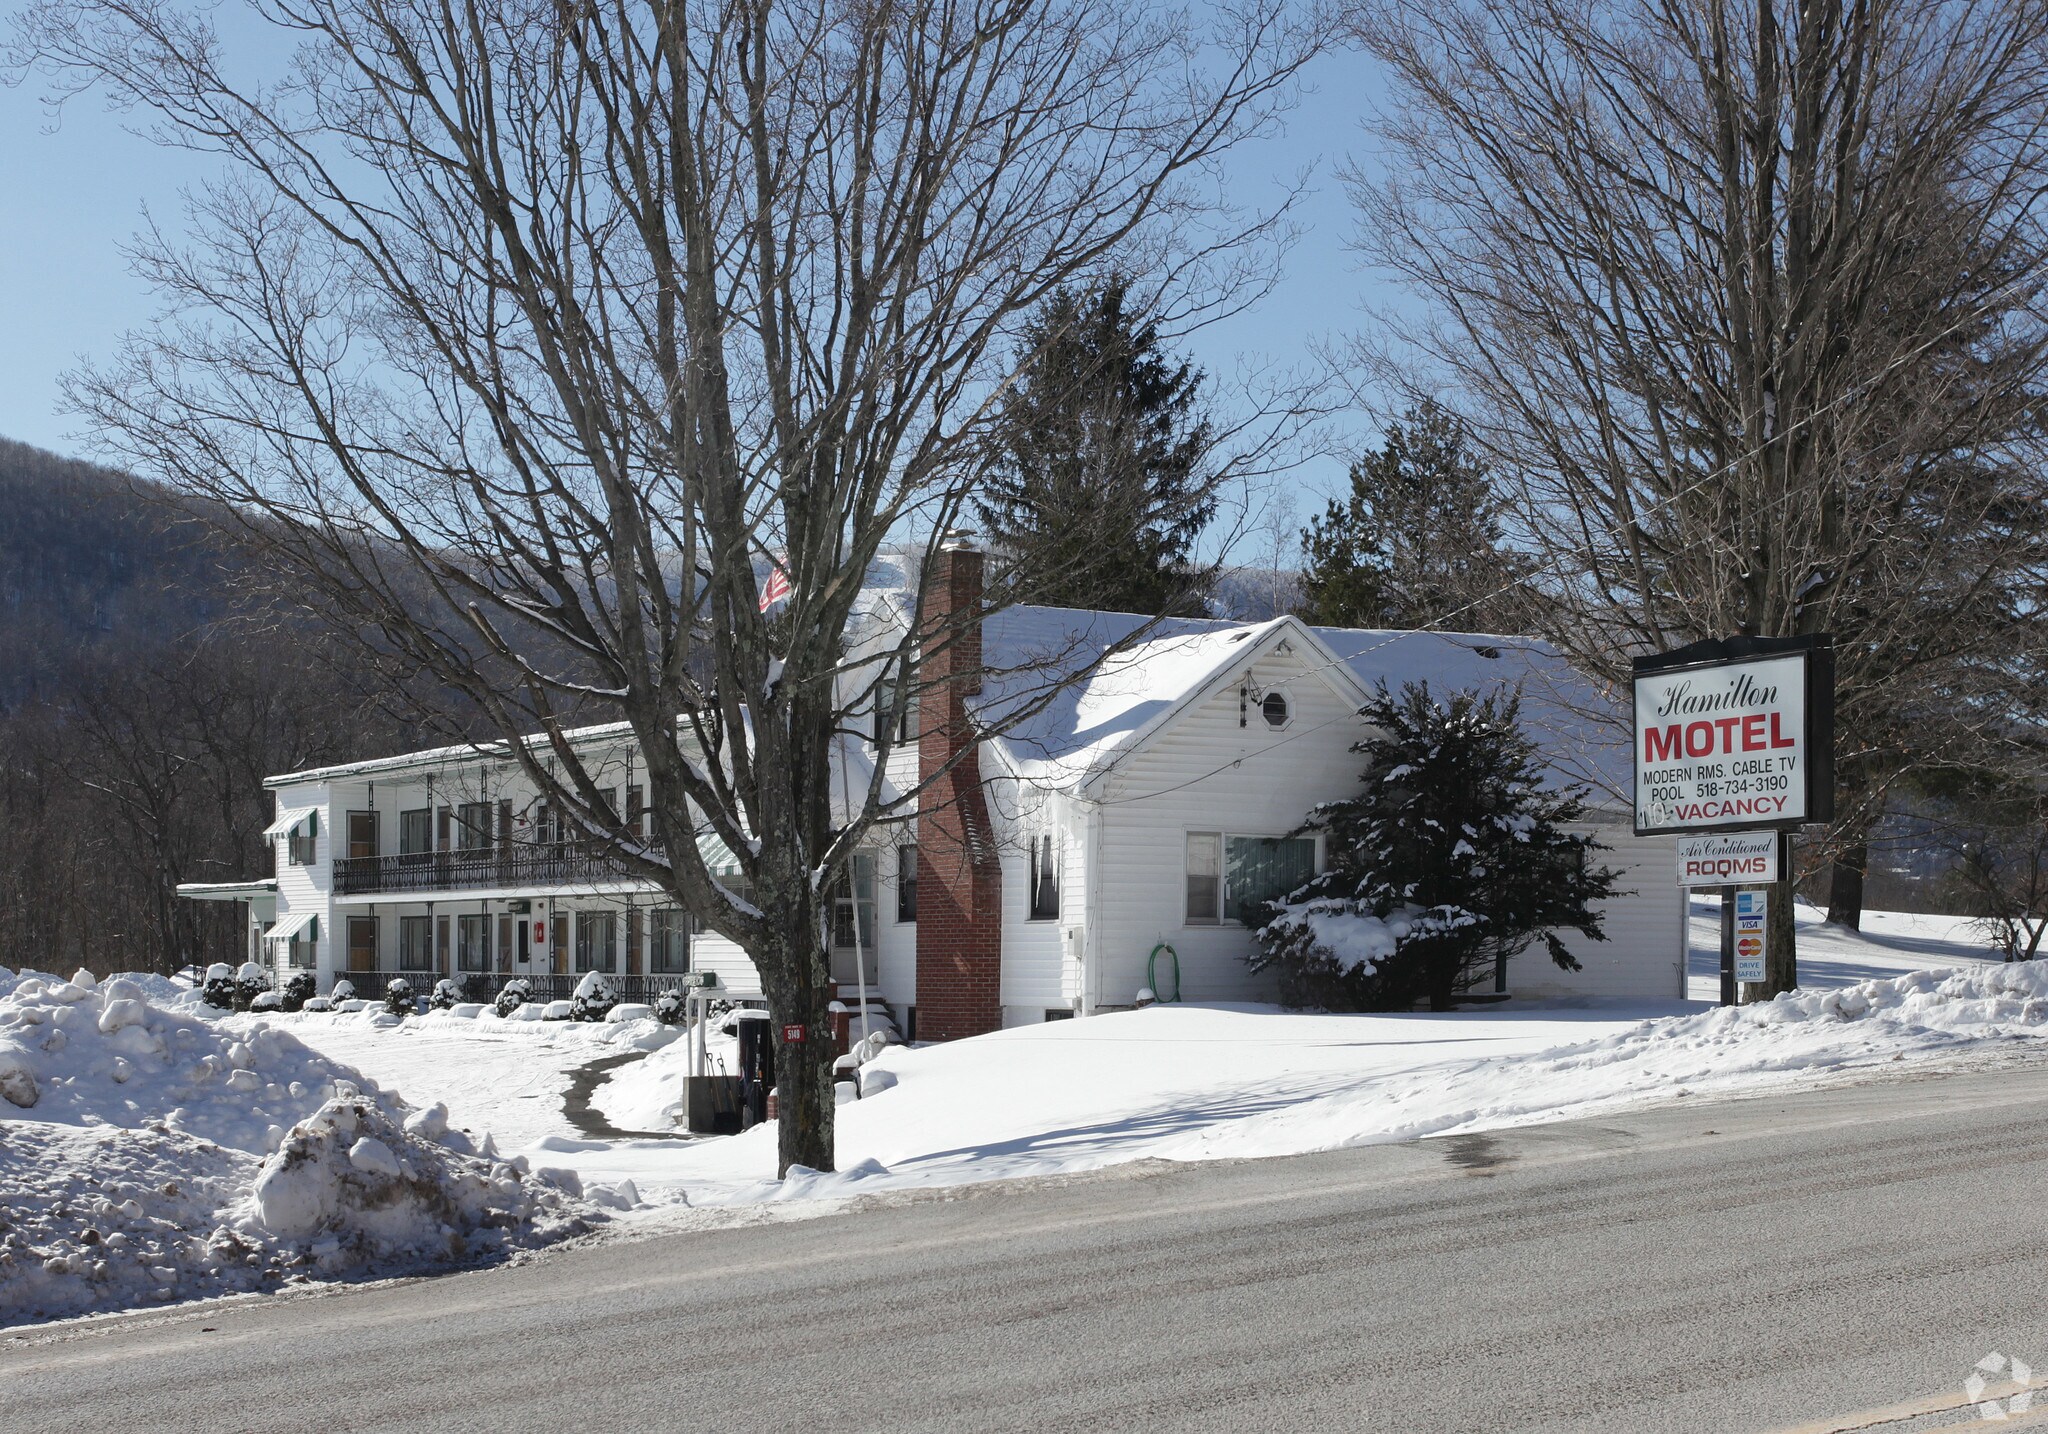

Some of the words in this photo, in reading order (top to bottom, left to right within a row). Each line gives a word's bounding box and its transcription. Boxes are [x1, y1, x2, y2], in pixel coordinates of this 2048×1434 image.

[1658, 673, 1778, 717] Hamilton
[1644, 712, 1795, 763] MOTEL
[1643, 767, 1692, 785] MODERN
[1697, 763, 1727, 780] RMS.
[1732, 759, 1773, 776] CABLE
[1779, 756, 1796, 771] TV
[1652, 786, 1685, 801] POOL
[1696, 775, 1788, 798] 518-734-3190
[1675, 795, 1788, 820] VACANCY
[1681, 841, 1702, 858] Air
[1703, 838, 1772, 857] Conditioned
[1686, 857, 1766, 877] ROOMS
[1742, 921, 1758, 929] VISA
[1737, 970, 1762, 978] SAFELY
